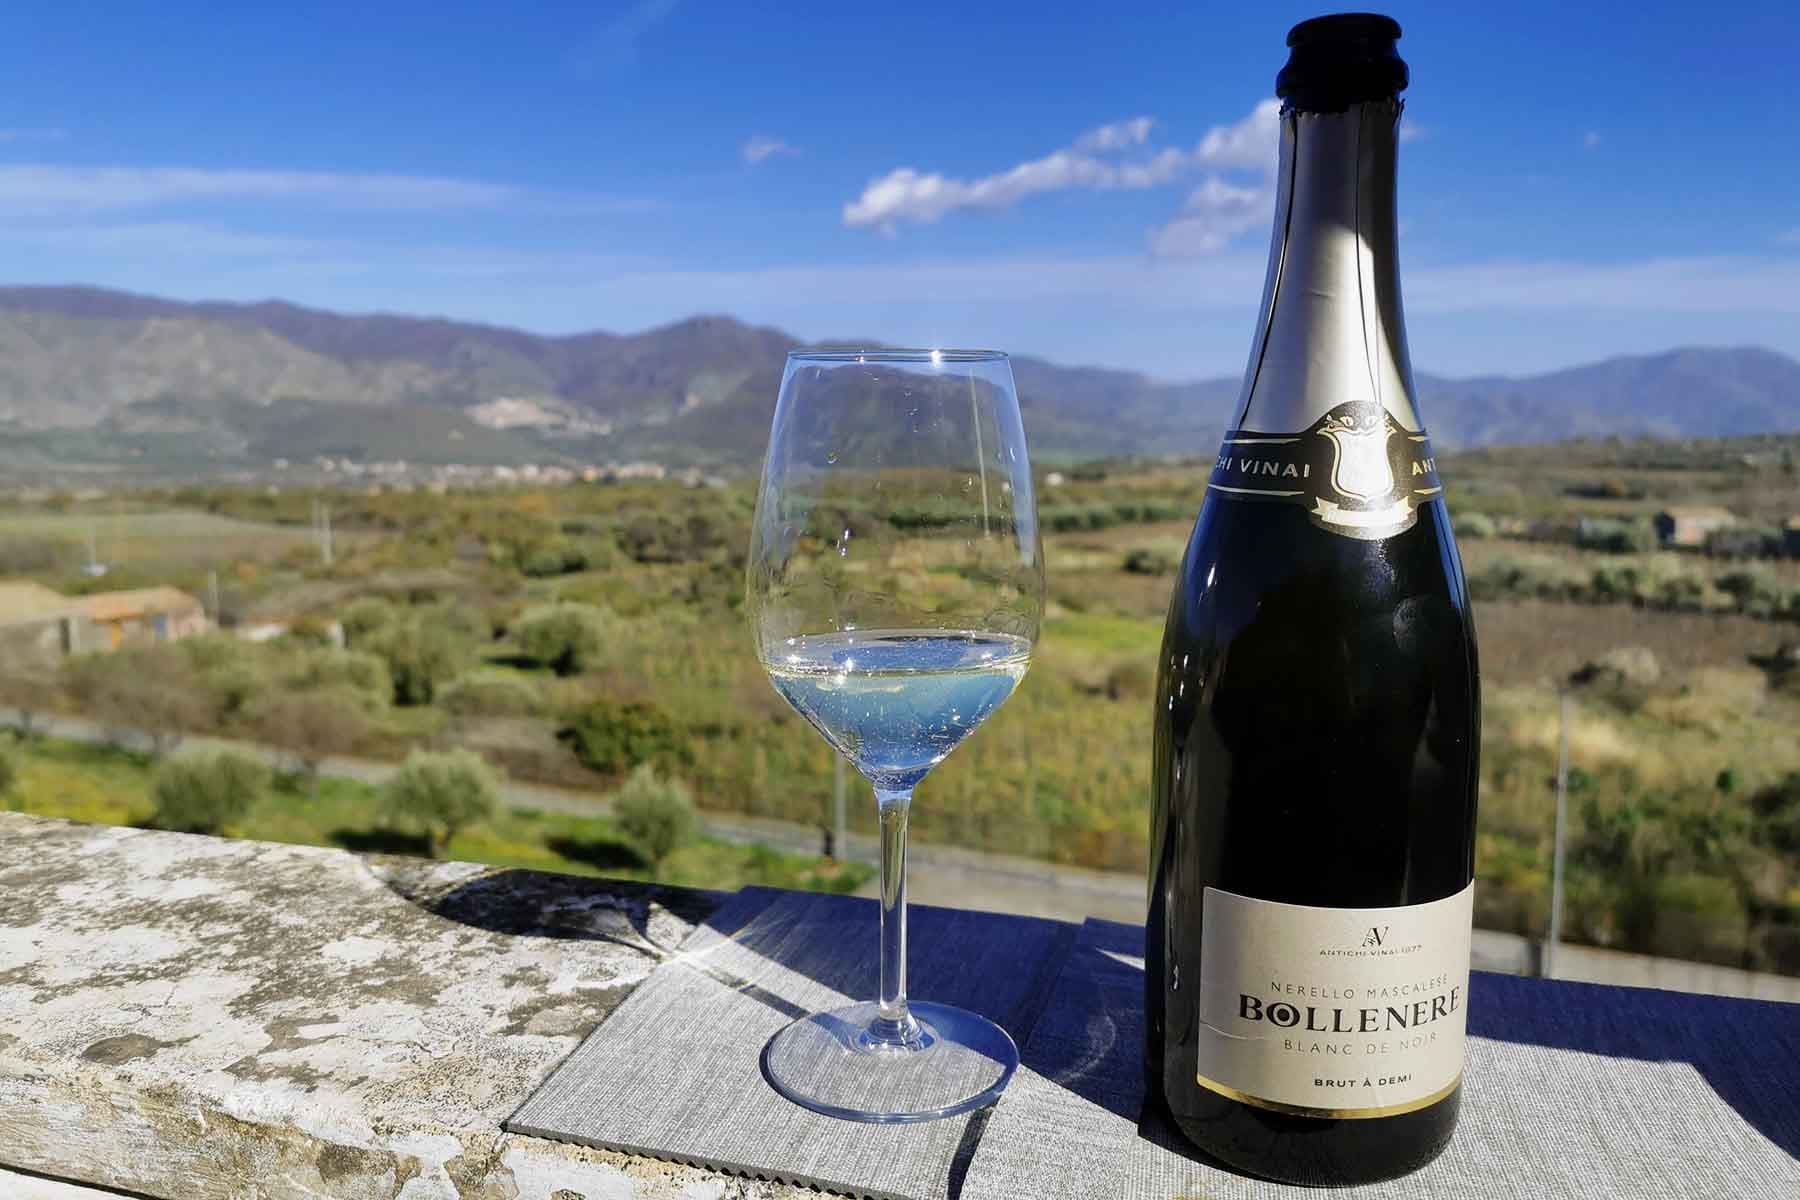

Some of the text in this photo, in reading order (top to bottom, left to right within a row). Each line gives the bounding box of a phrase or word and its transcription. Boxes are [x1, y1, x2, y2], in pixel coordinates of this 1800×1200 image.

[1240, 458, 1310, 478] VINAI
[1319, 949, 1367, 957] ANTICHI
[1271, 974, 1448, 999] NERELLO MASCALESE
[1239, 986, 1460, 1033] BOLLENERE
[1284, 1031, 1437, 1055] BLANC DE NOIR
[1314, 1078, 1356, 1088] BRUT
[1378, 1074, 1413, 1087] DEMI
